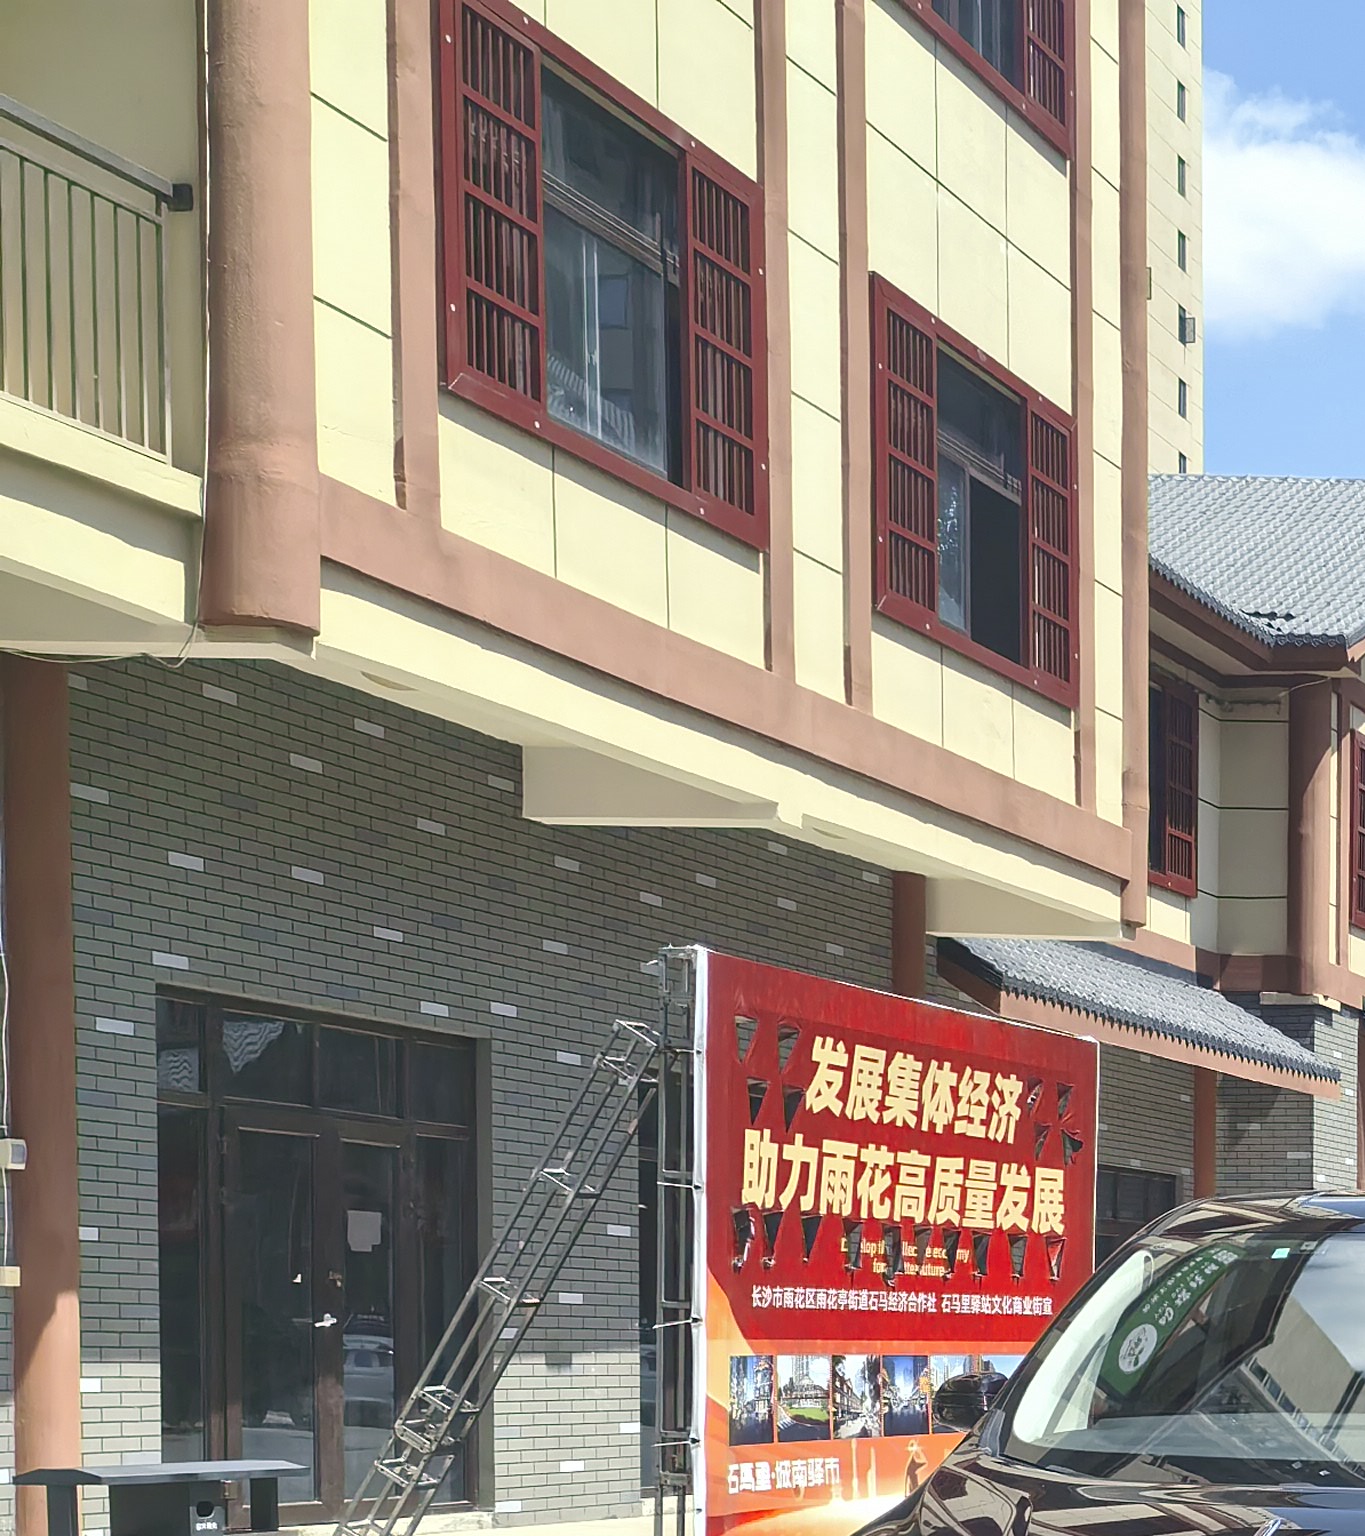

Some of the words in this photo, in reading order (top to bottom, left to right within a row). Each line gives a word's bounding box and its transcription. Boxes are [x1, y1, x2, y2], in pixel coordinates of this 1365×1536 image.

[805, 1036, 1024, 1144] 发展集体经济
[742, 1128, 1066, 1235] 助力雨花高质量发展
